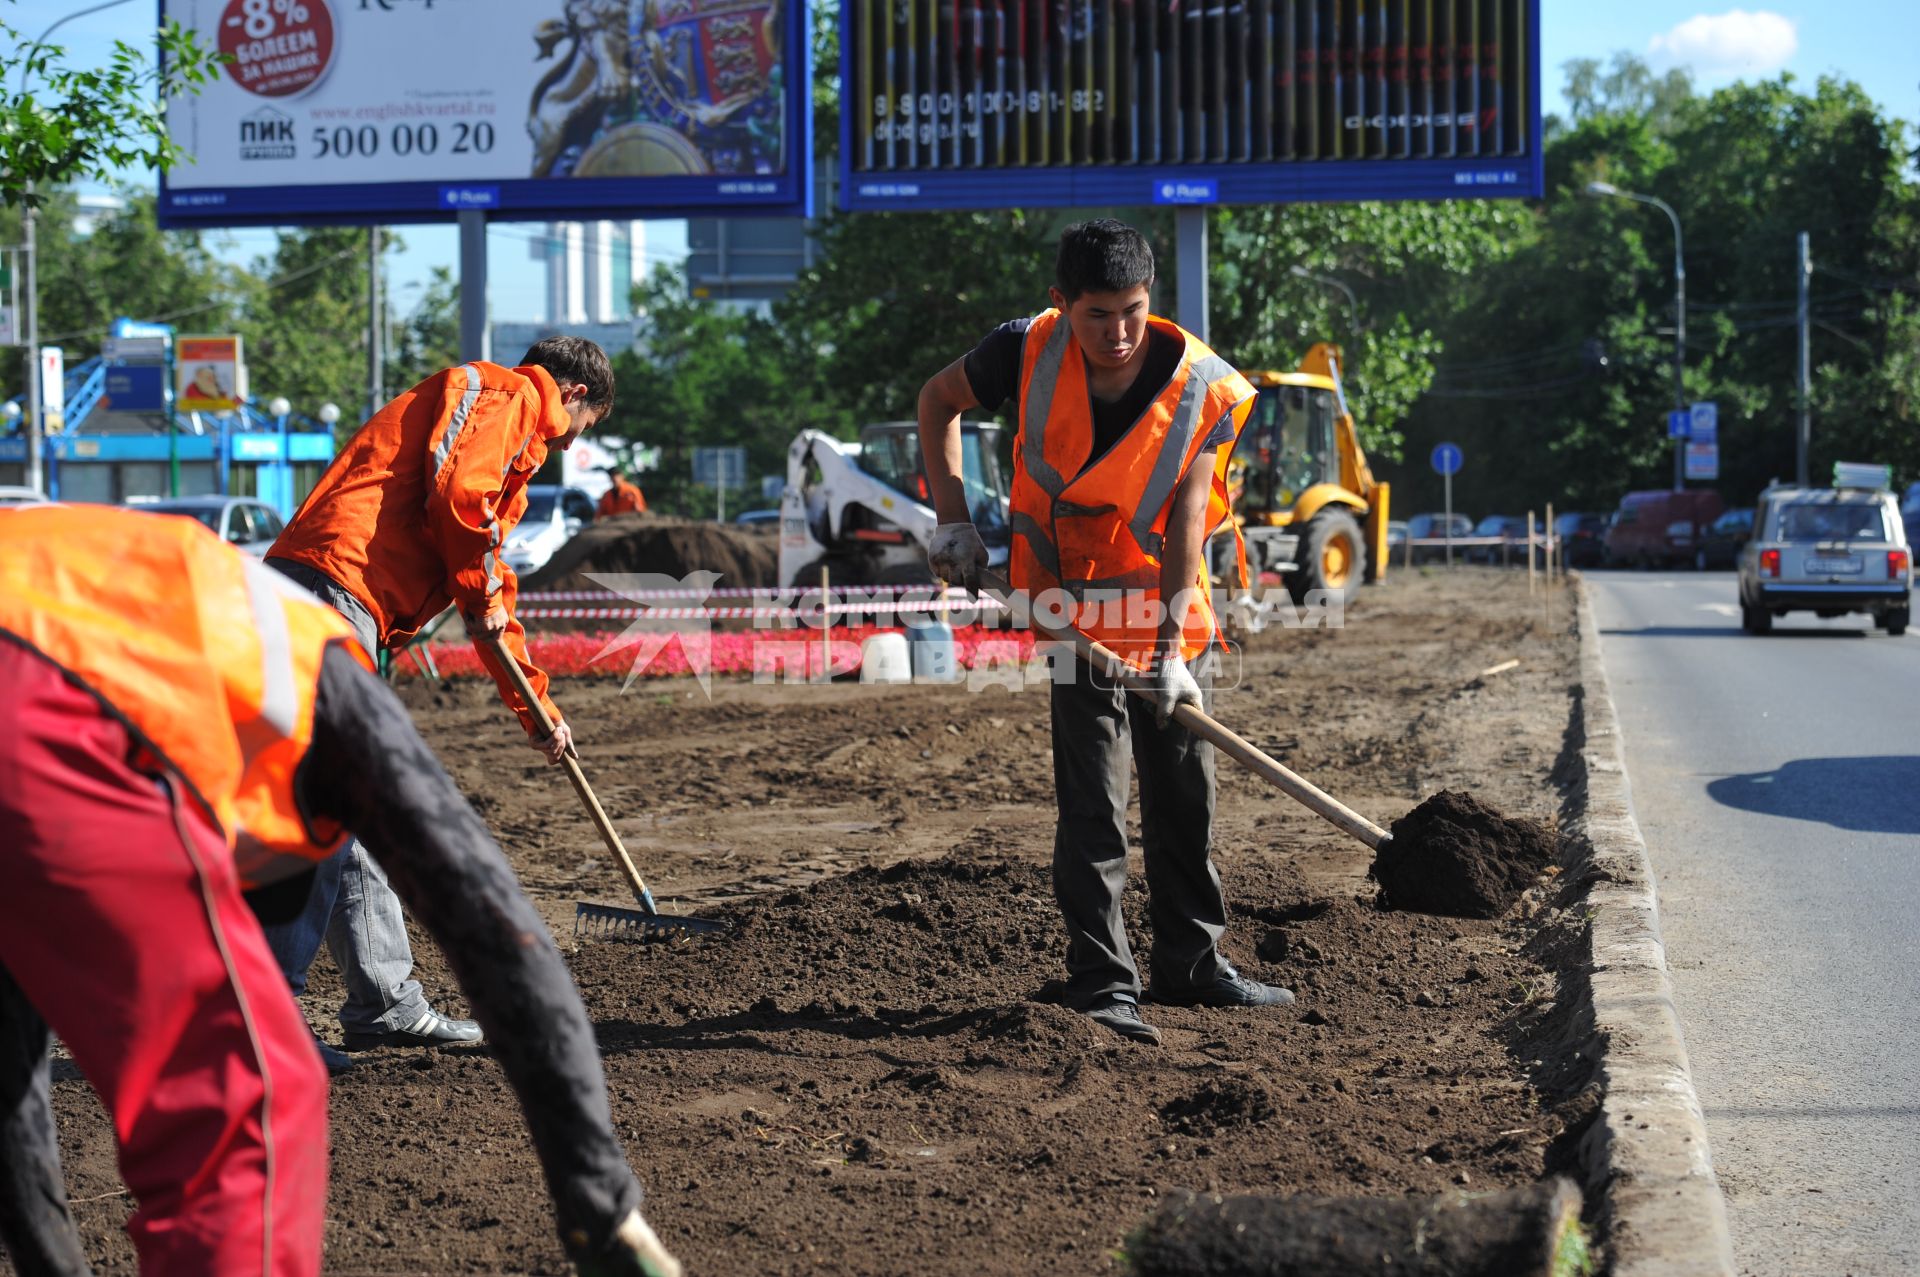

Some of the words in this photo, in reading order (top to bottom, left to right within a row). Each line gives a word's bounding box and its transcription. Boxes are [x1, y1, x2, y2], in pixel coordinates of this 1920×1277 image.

[226, 0, 309, 40] -8%
[235, 28, 318, 64] БОЛЕЕМ
[241, 63, 262, 82] ЗА
[262, 50, 320, 77] НАШИХ
[310, 102, 497, 121] www.englishkvartal.ru
[240, 118, 295, 142] ПИК
[312, 124, 380, 159] 500
[391, 122, 439, 157] 00
[451, 120, 496, 154] 20
